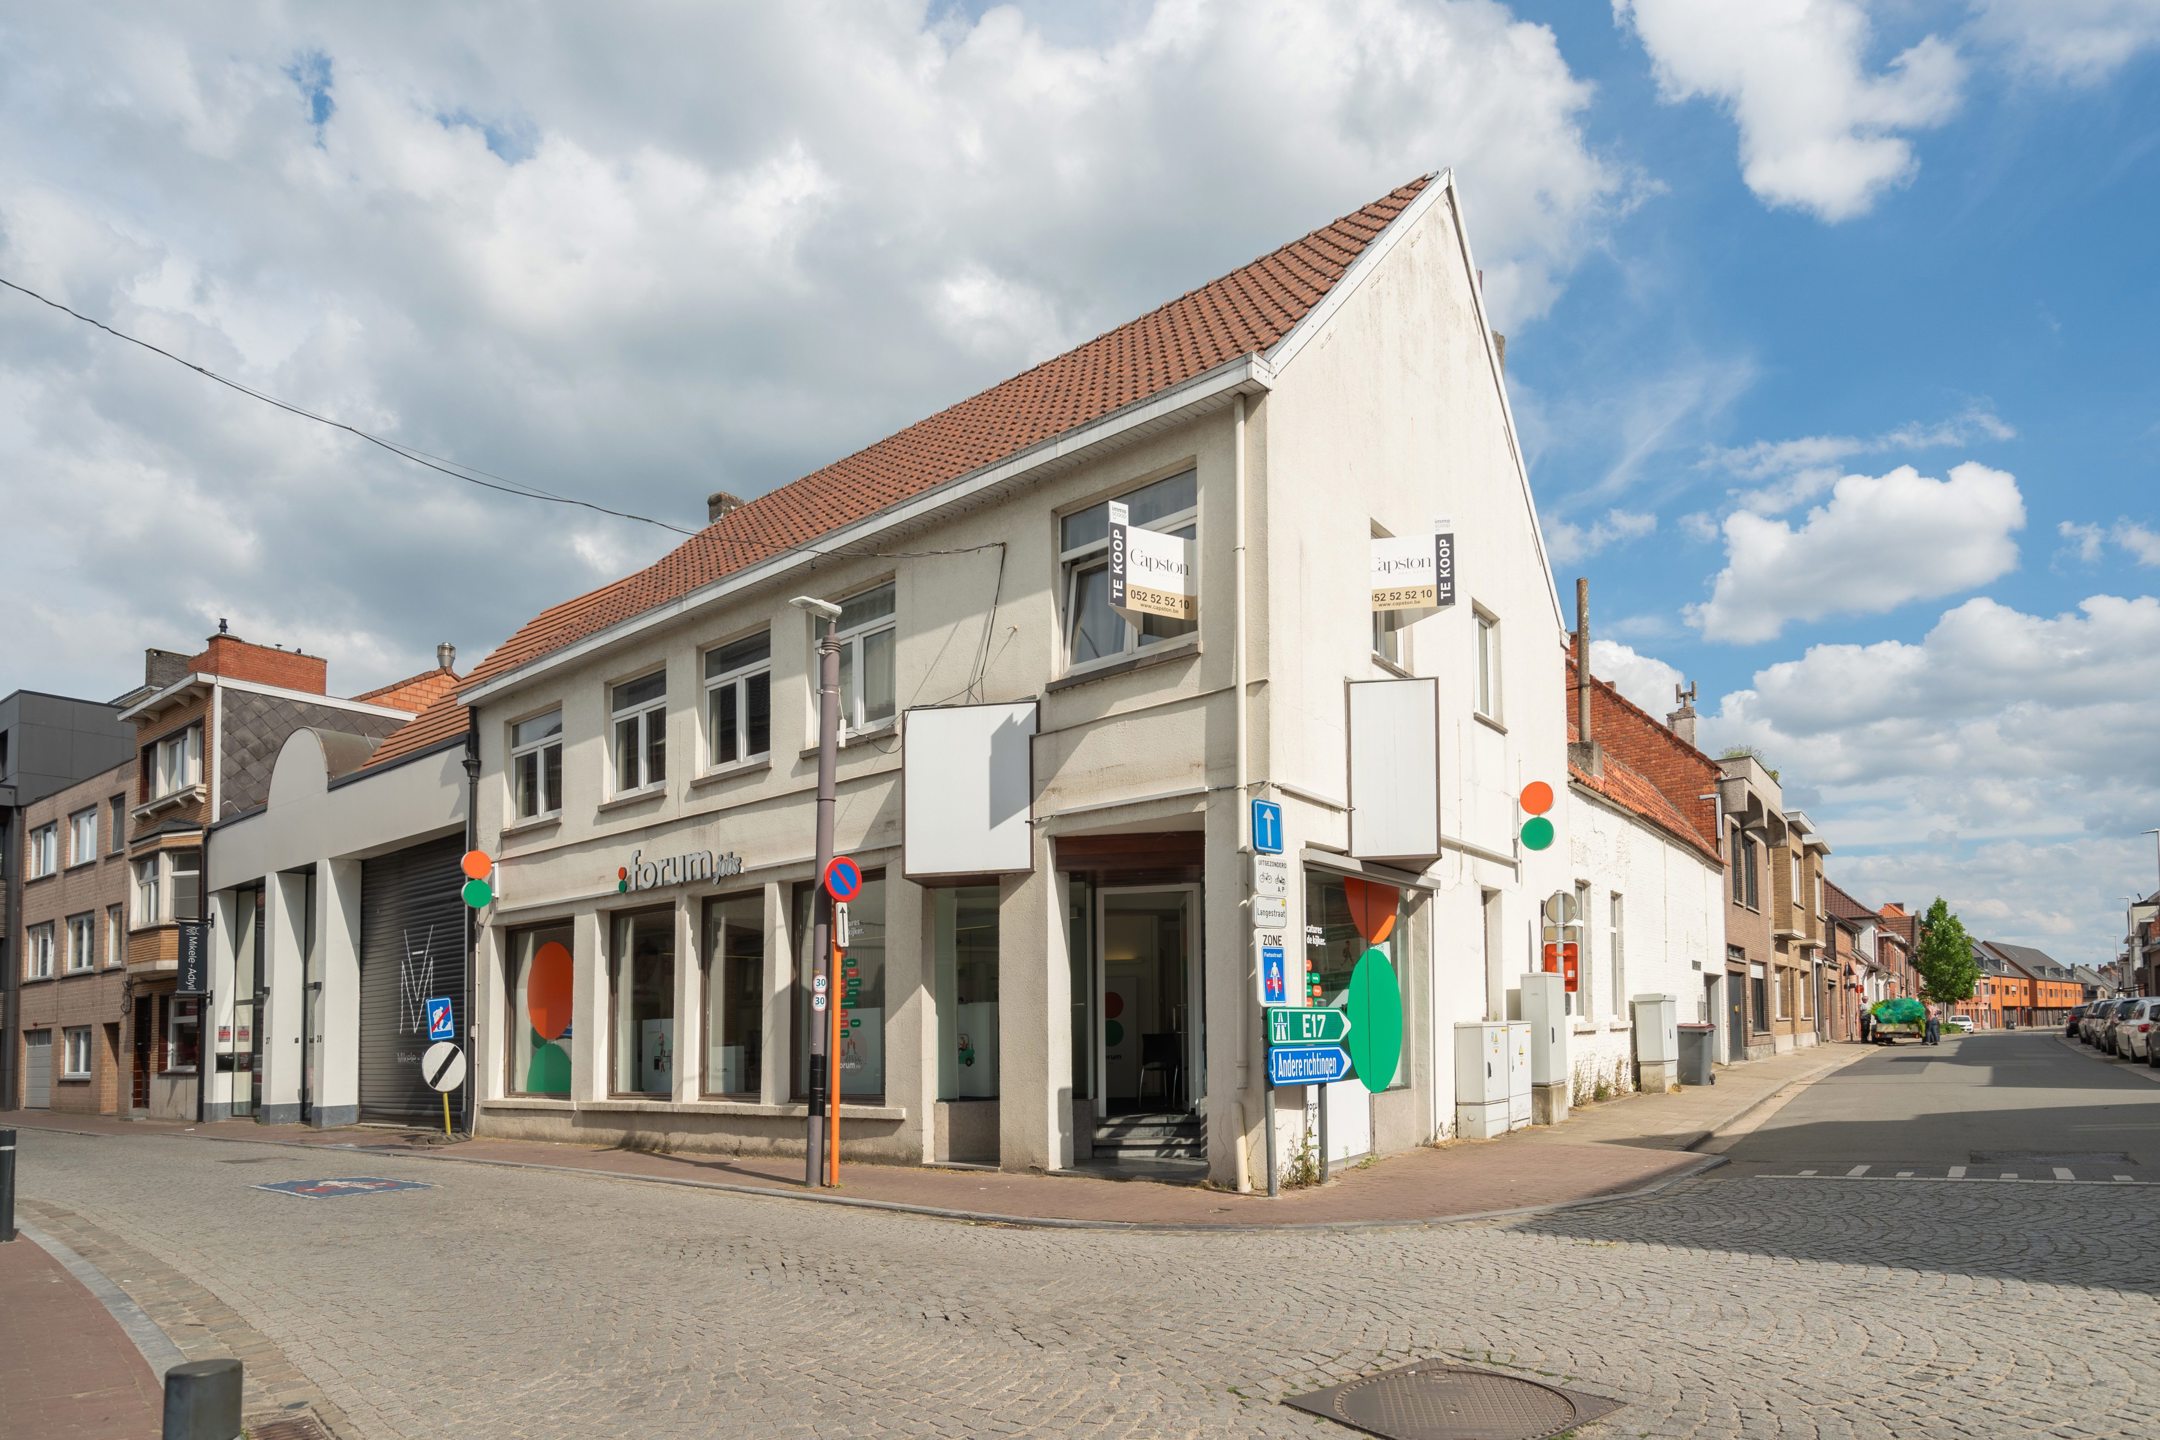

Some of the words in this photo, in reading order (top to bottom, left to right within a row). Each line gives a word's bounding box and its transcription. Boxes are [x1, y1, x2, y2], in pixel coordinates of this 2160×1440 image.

[1113, 529, 1123, 574] KOOP
[1130, 548, 1189, 576] Capston
[1439, 539, 1450, 577] KOOP
[1113, 579, 1123, 598] TE
[1390, 592, 1401, 600] 52
[1405, 590, 1416, 599] 52
[1421, 589, 1432, 598] 10
[1440, 582, 1451, 599] TE
[1130, 589, 1148, 601] 052
[1151, 594, 1162, 605] 52
[1164, 596, 1176, 607] 52
[1179, 599, 1190, 610] 10
[631, 850, 713, 890] forum
[713, 852, 742, 886] jobs
[1258, 860, 1287, 869] UITGEZONDERD
[1258, 908, 1285, 918] Langestraat
[1263, 934, 1282, 946] ZONE
[1302, 1014, 1326, 1038] E17
[1278, 1053, 1303, 1078] Andere
[1303, 1054, 1337, 1080] richtingen
